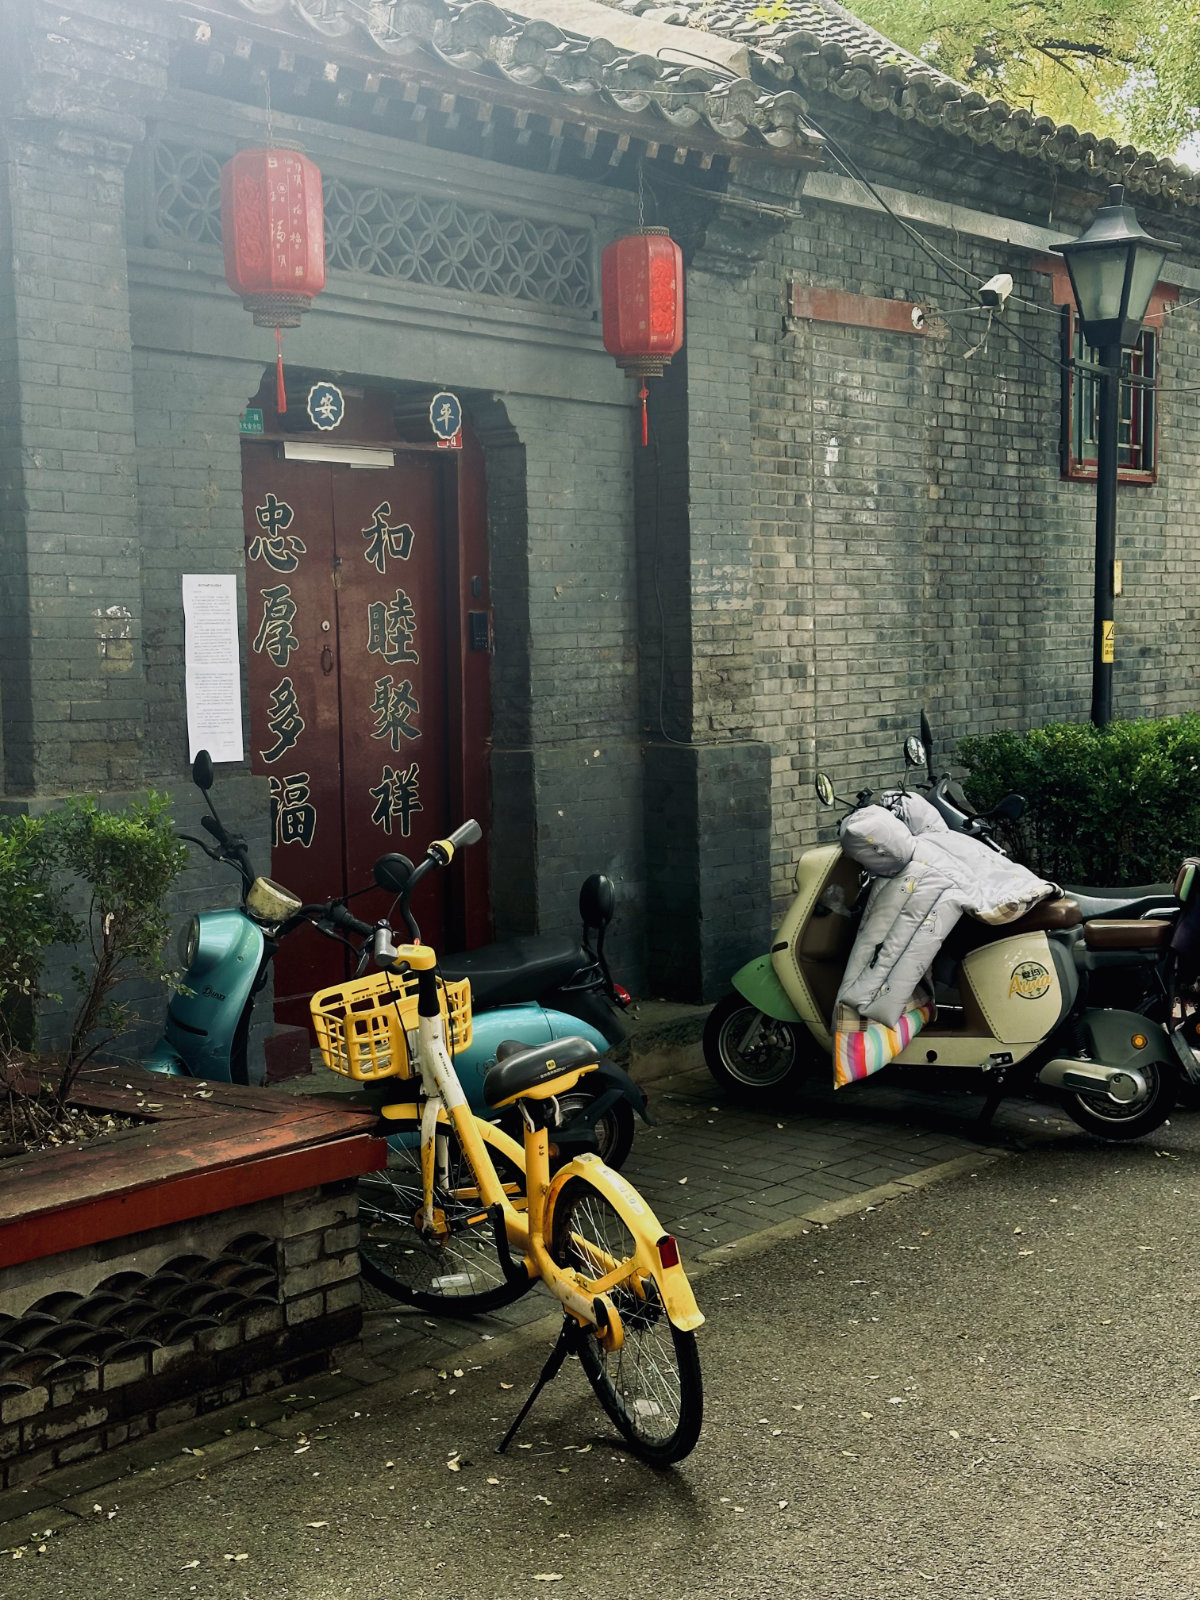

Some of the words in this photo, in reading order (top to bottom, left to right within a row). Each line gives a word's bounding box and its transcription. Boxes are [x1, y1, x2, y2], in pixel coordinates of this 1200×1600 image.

[314, 392, 338, 421] 安
[436, 402, 455, 431] 平
[248, 493, 317, 848] 忠厚多福
[361, 501, 425, 838] 和睦聚祥
